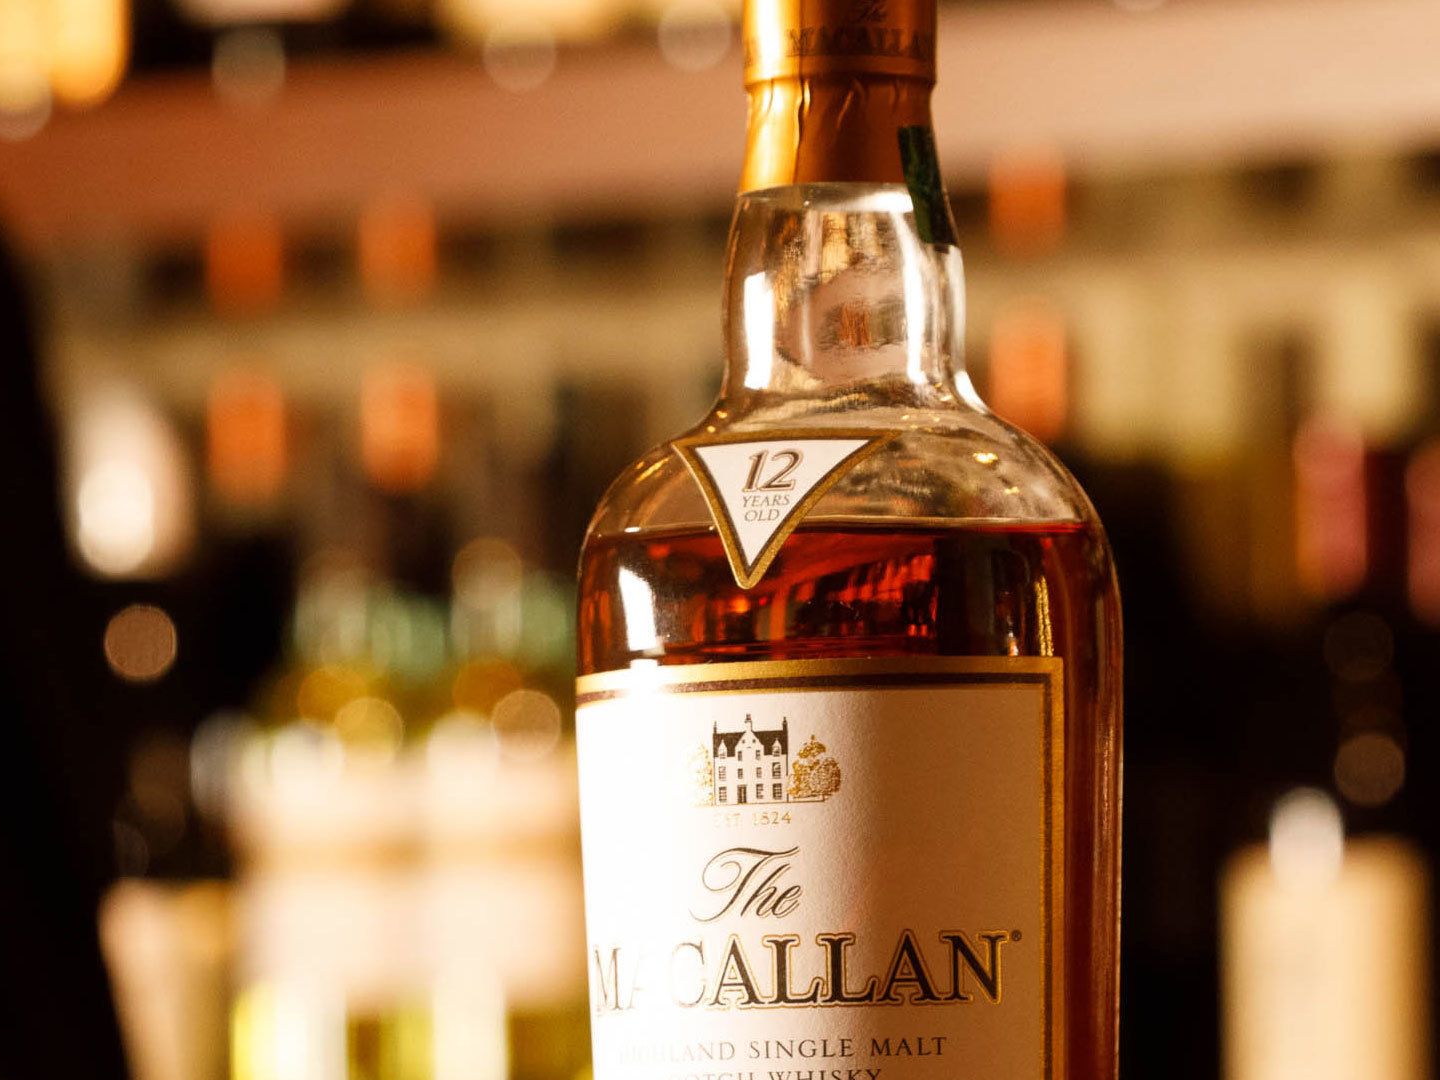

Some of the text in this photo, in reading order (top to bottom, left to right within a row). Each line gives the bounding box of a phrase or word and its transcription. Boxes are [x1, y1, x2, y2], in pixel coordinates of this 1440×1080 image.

[741, 448, 804, 492] 12
[742, 494, 791, 509] YEARS
[744, 508, 781, 522] OLD
[688, 846, 803, 922] The
[749, 1038, 854, 1060] SINGLE
[871, 1037, 947, 1057] MALT
